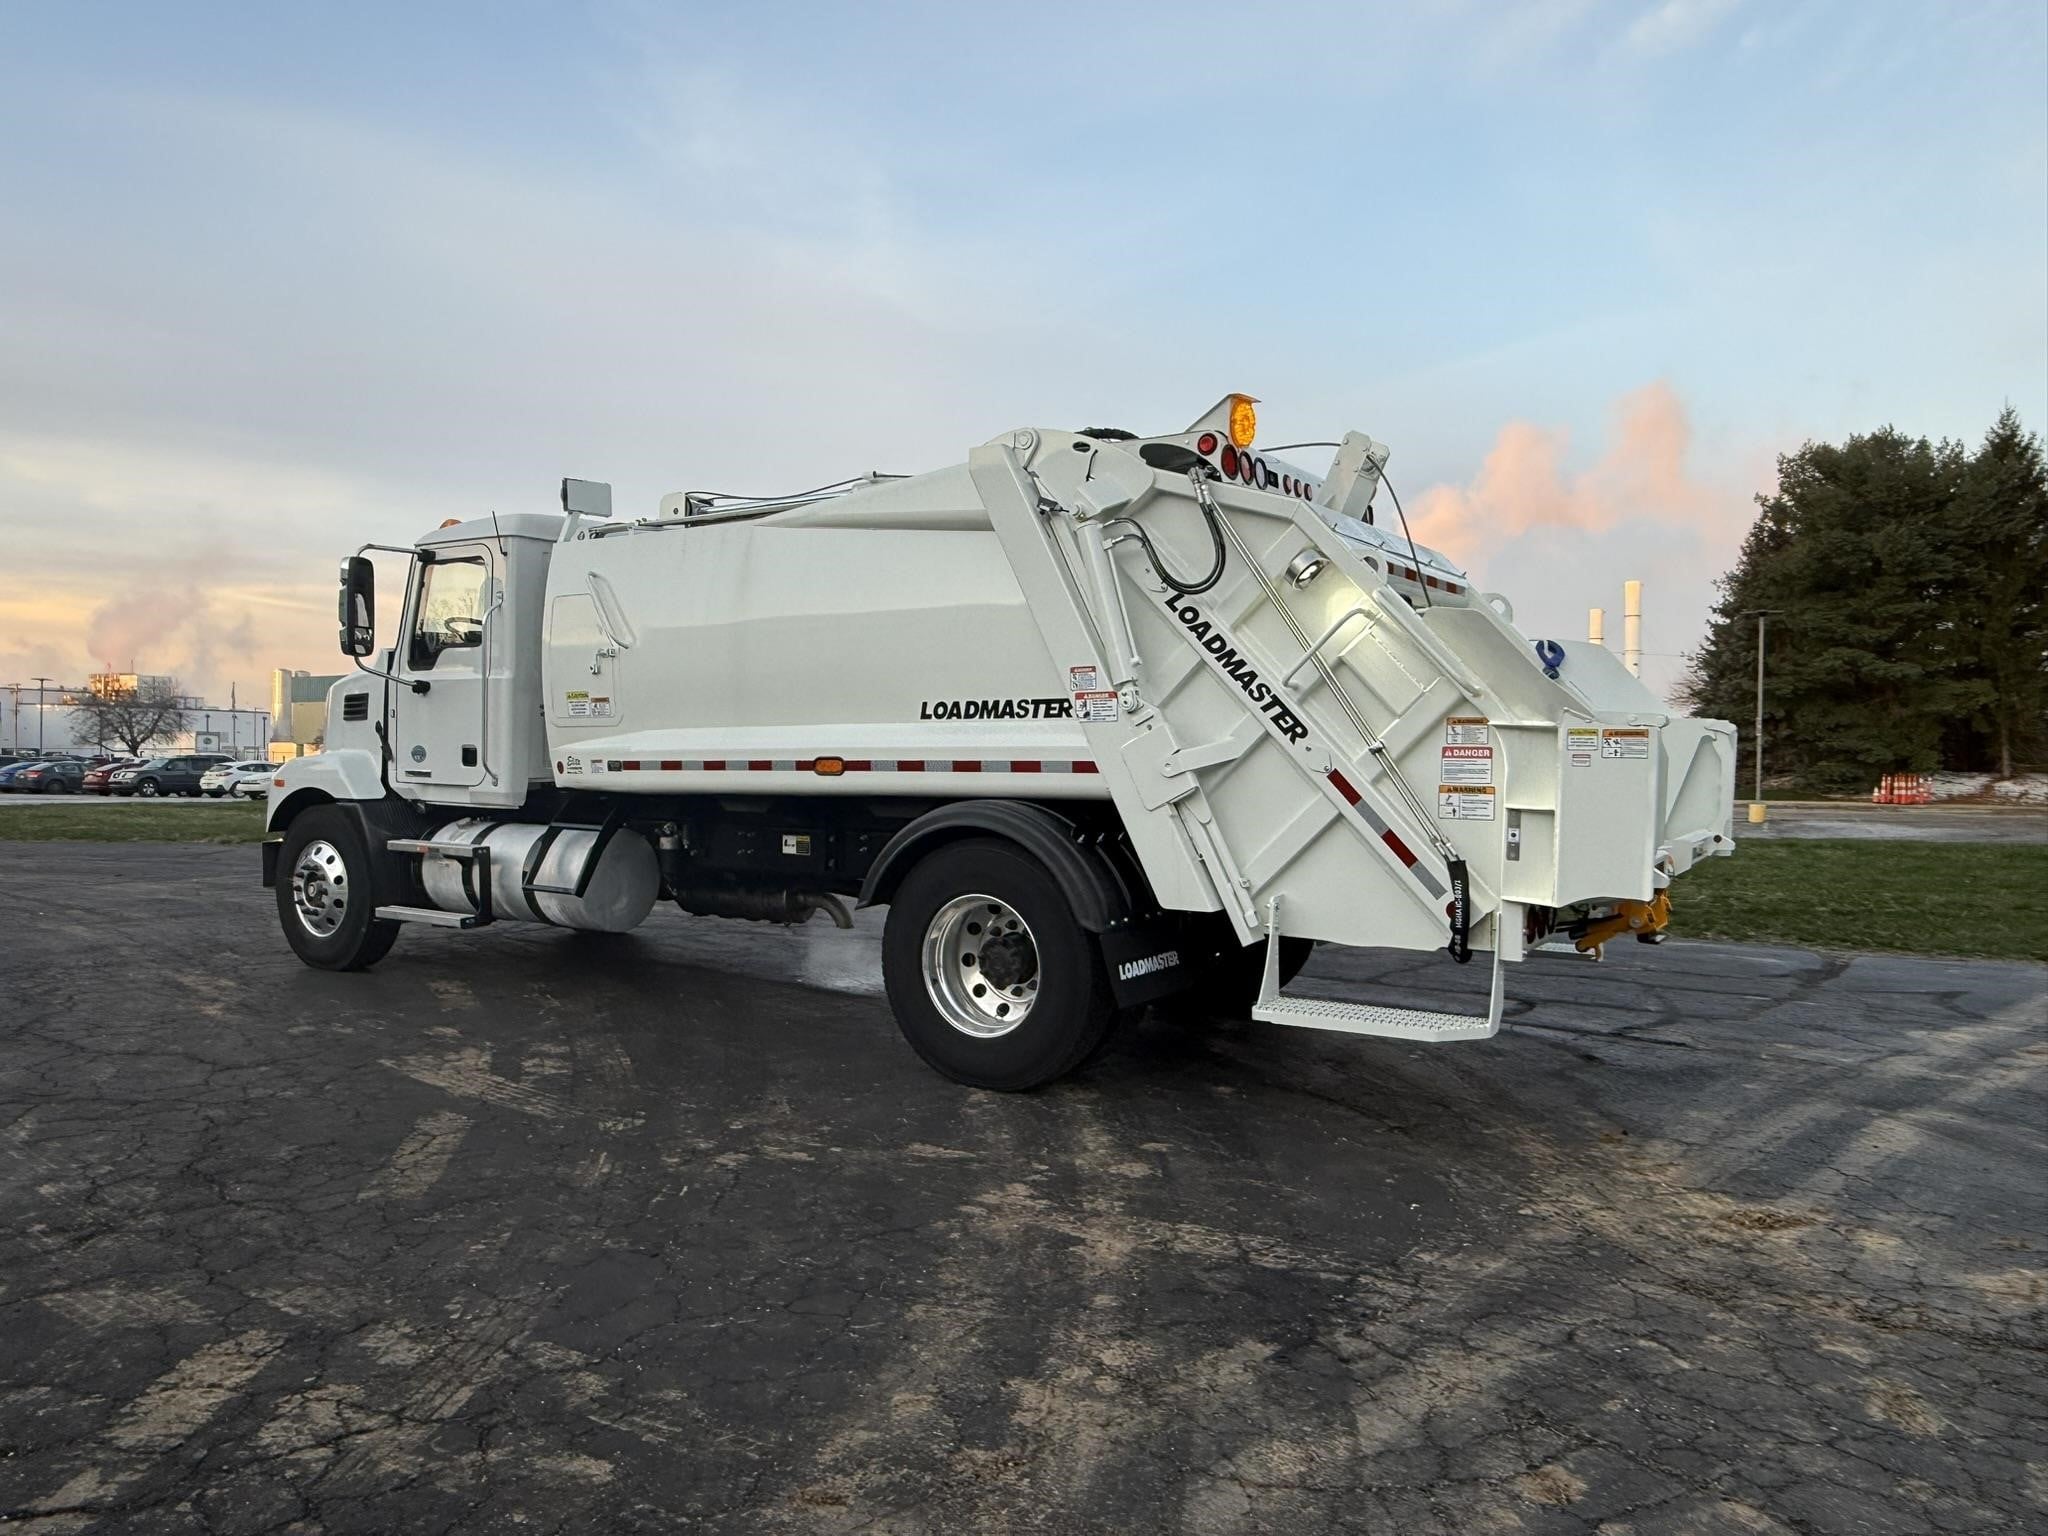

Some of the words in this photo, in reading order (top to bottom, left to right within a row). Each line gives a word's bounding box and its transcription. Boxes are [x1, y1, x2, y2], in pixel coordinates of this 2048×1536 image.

[1164, 592, 1309, 745] LOADMASTER
[920, 698, 1073, 720] LOADMASTER
[1453, 749, 1490, 757] DANGER
[1118, 951, 1179, 981] LOADMASTER
